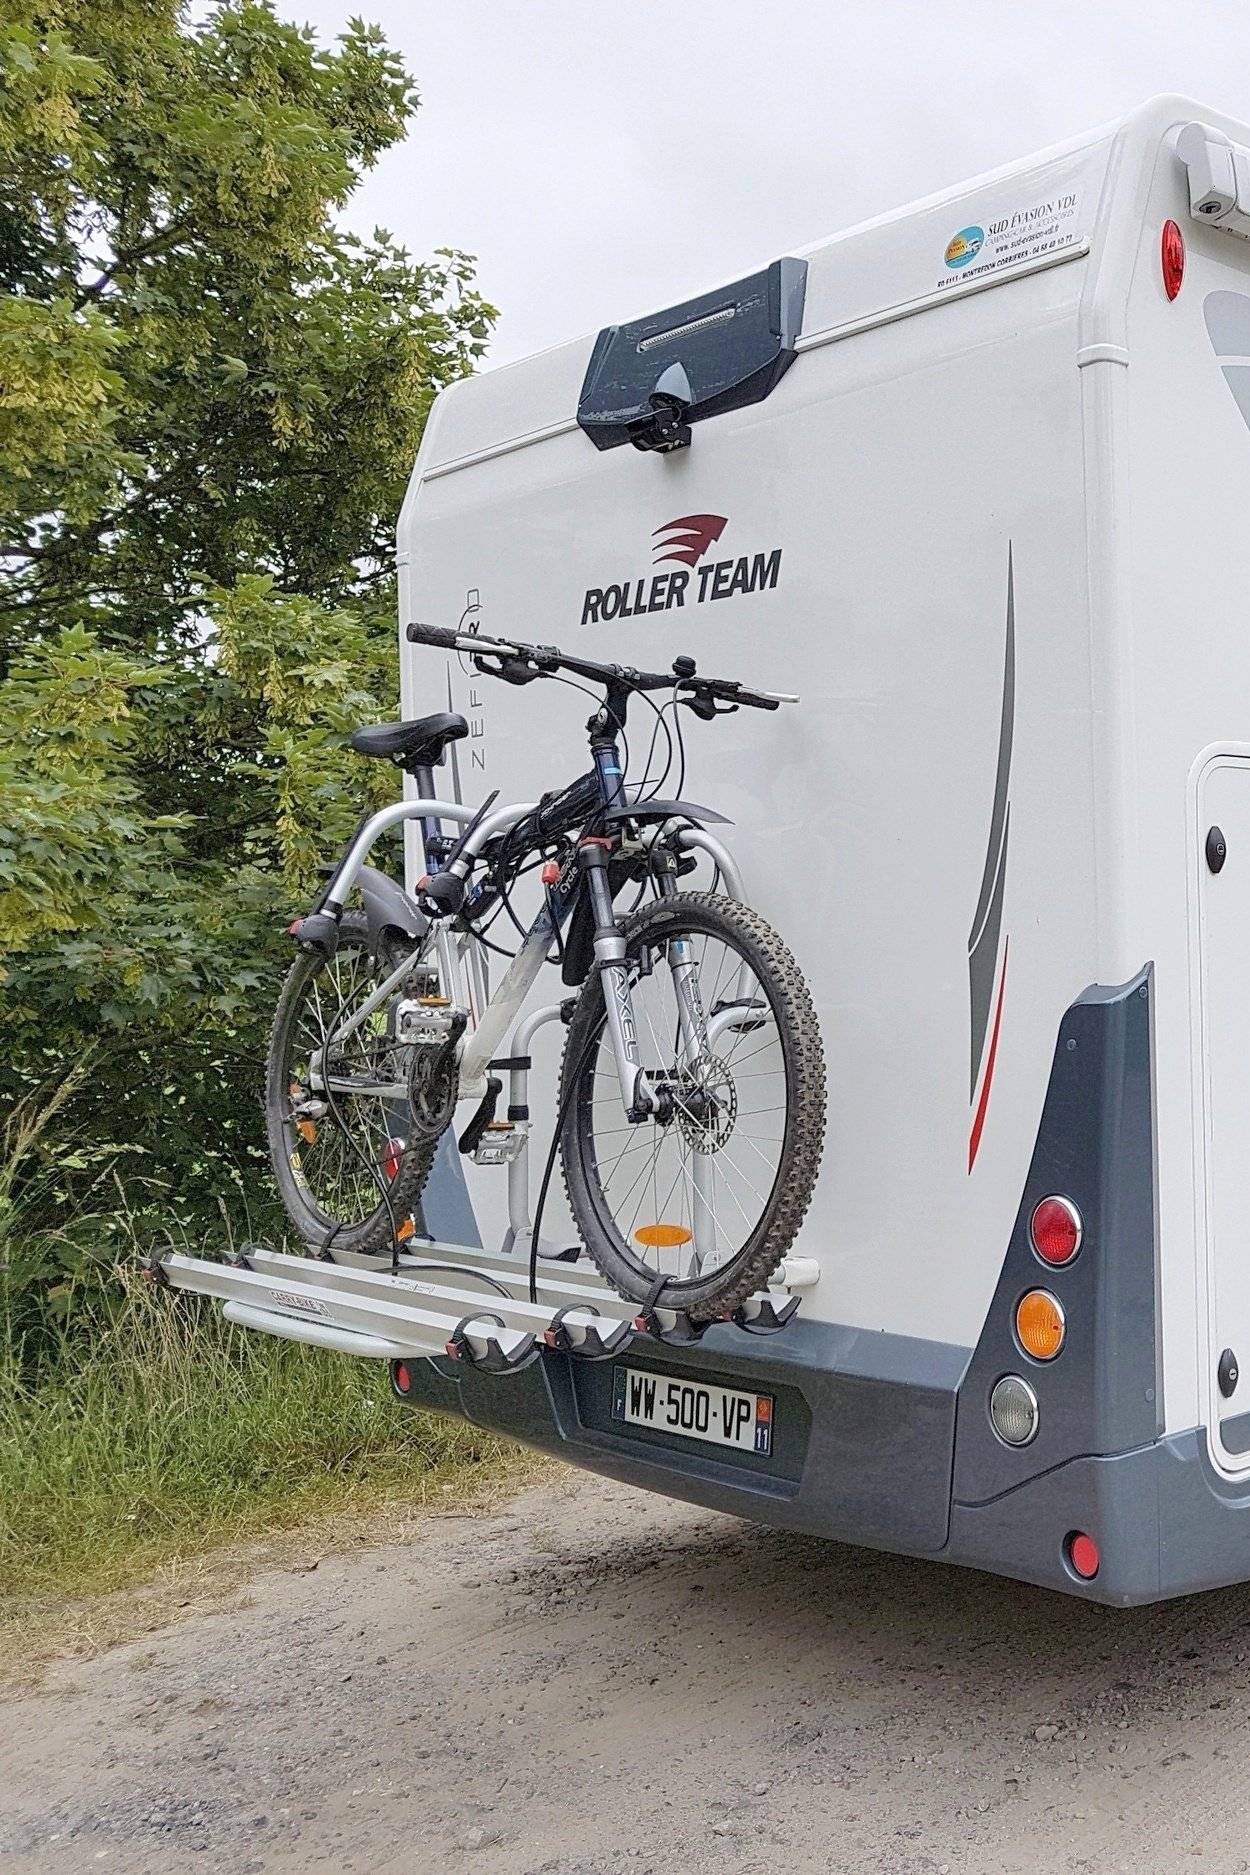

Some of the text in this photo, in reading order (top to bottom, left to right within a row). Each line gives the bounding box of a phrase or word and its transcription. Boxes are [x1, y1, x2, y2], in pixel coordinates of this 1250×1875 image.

[987, 194, 1078, 237] SUD ÉVASION VDL
[580, 549, 782, 625] ROLLER TEAM
[614, 967, 638, 1060] AXEL
[615, 1375, 768, 1450] F WW-500-VP 11
